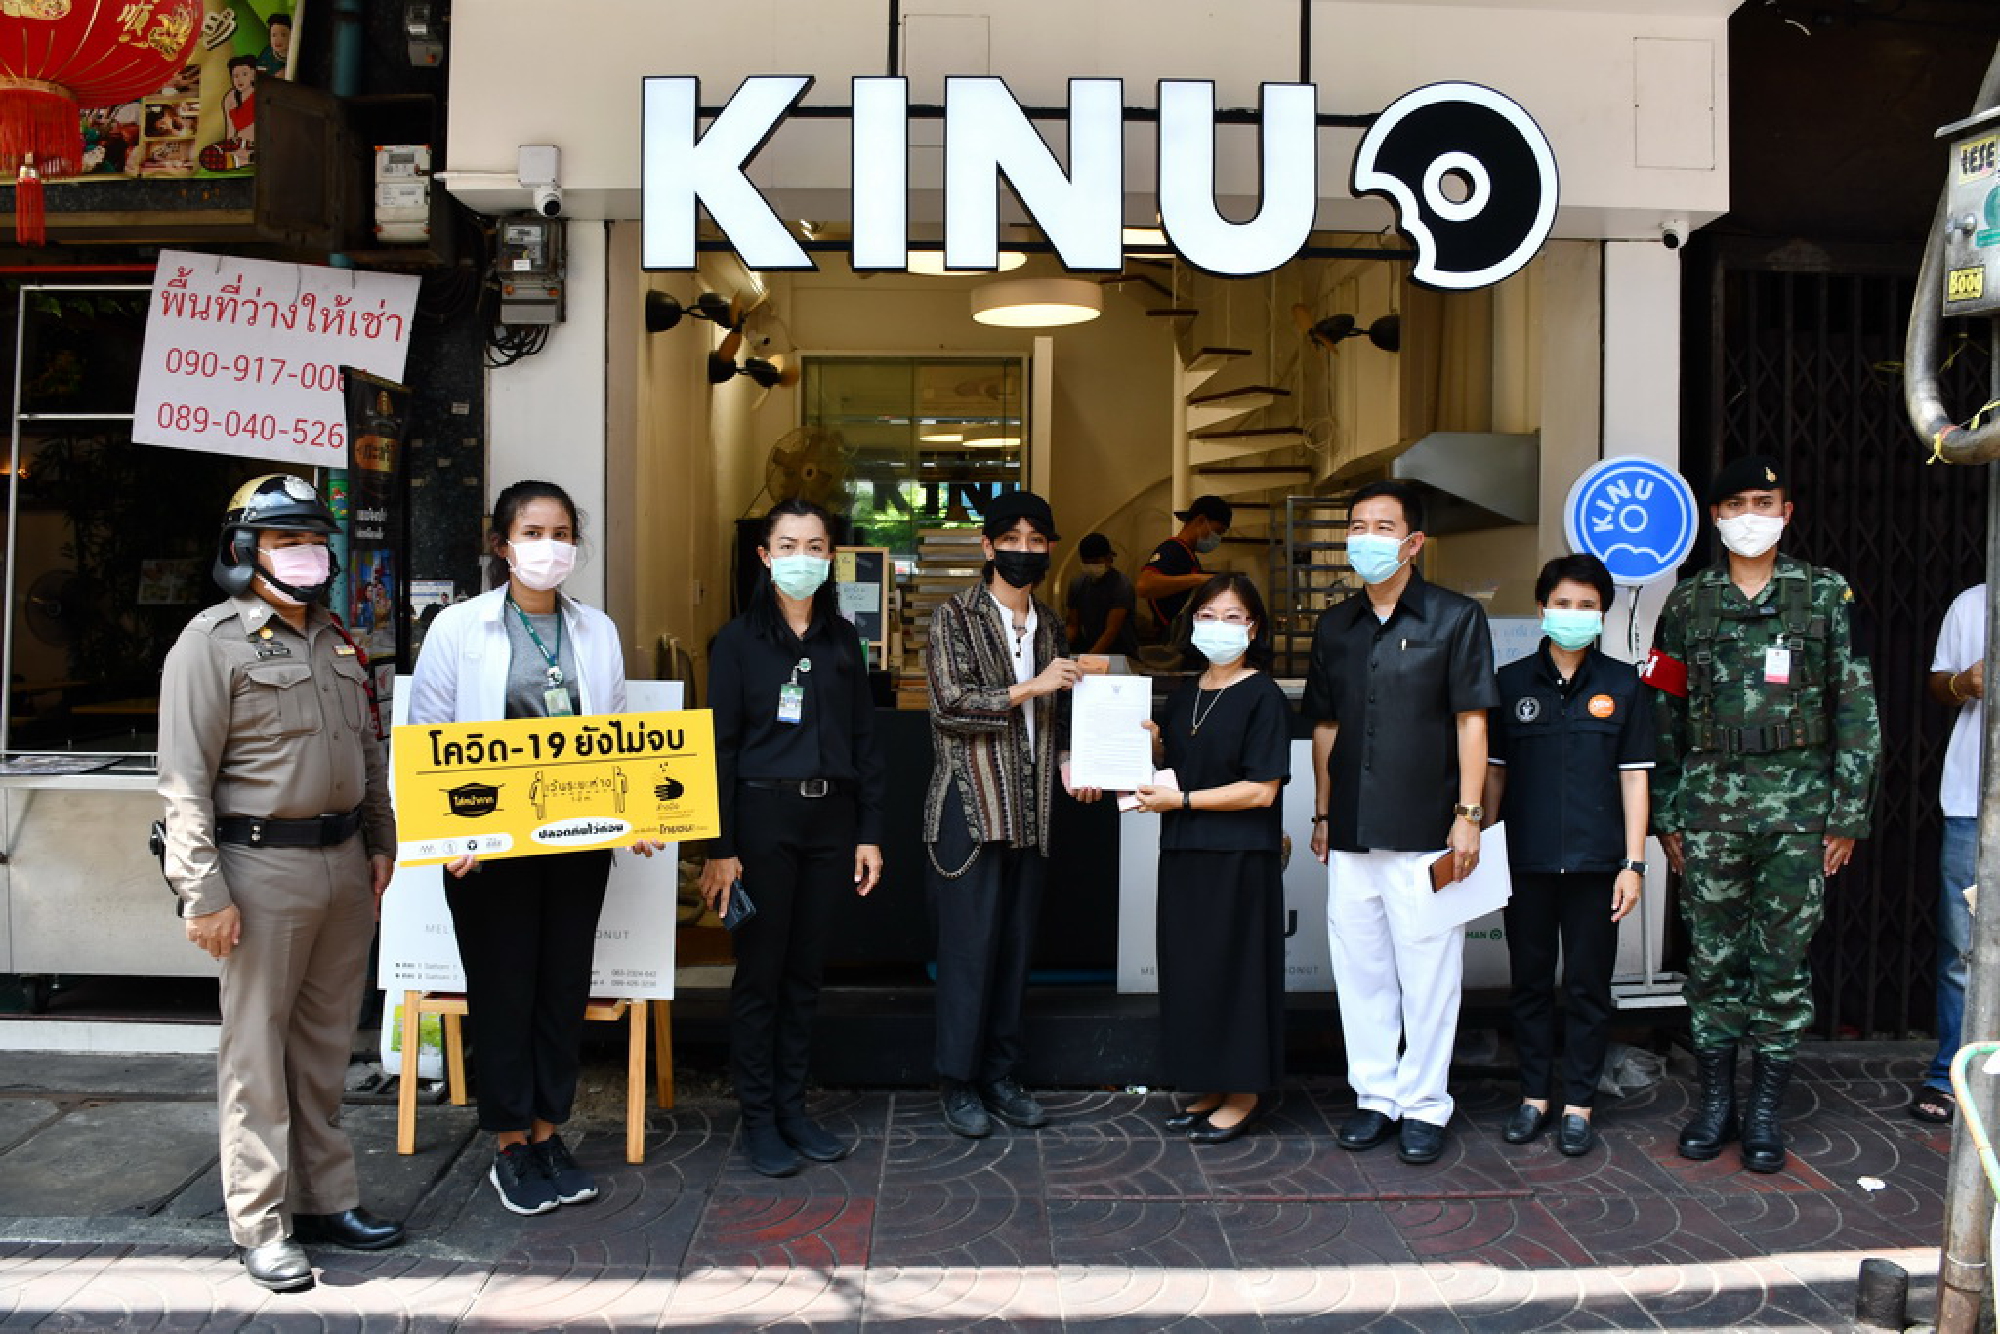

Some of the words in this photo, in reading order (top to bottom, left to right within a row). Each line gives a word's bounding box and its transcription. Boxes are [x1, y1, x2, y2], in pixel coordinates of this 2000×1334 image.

[642, 75, 1318, 275] KINU
[160, 265, 403, 342] พื้นที่ว่างให้เช่า
[1591, 478, 1655, 533] KINU
[428, 729, 566, 766] โควิด-19
[574, 720, 685, 757] ยังไม่จบ
